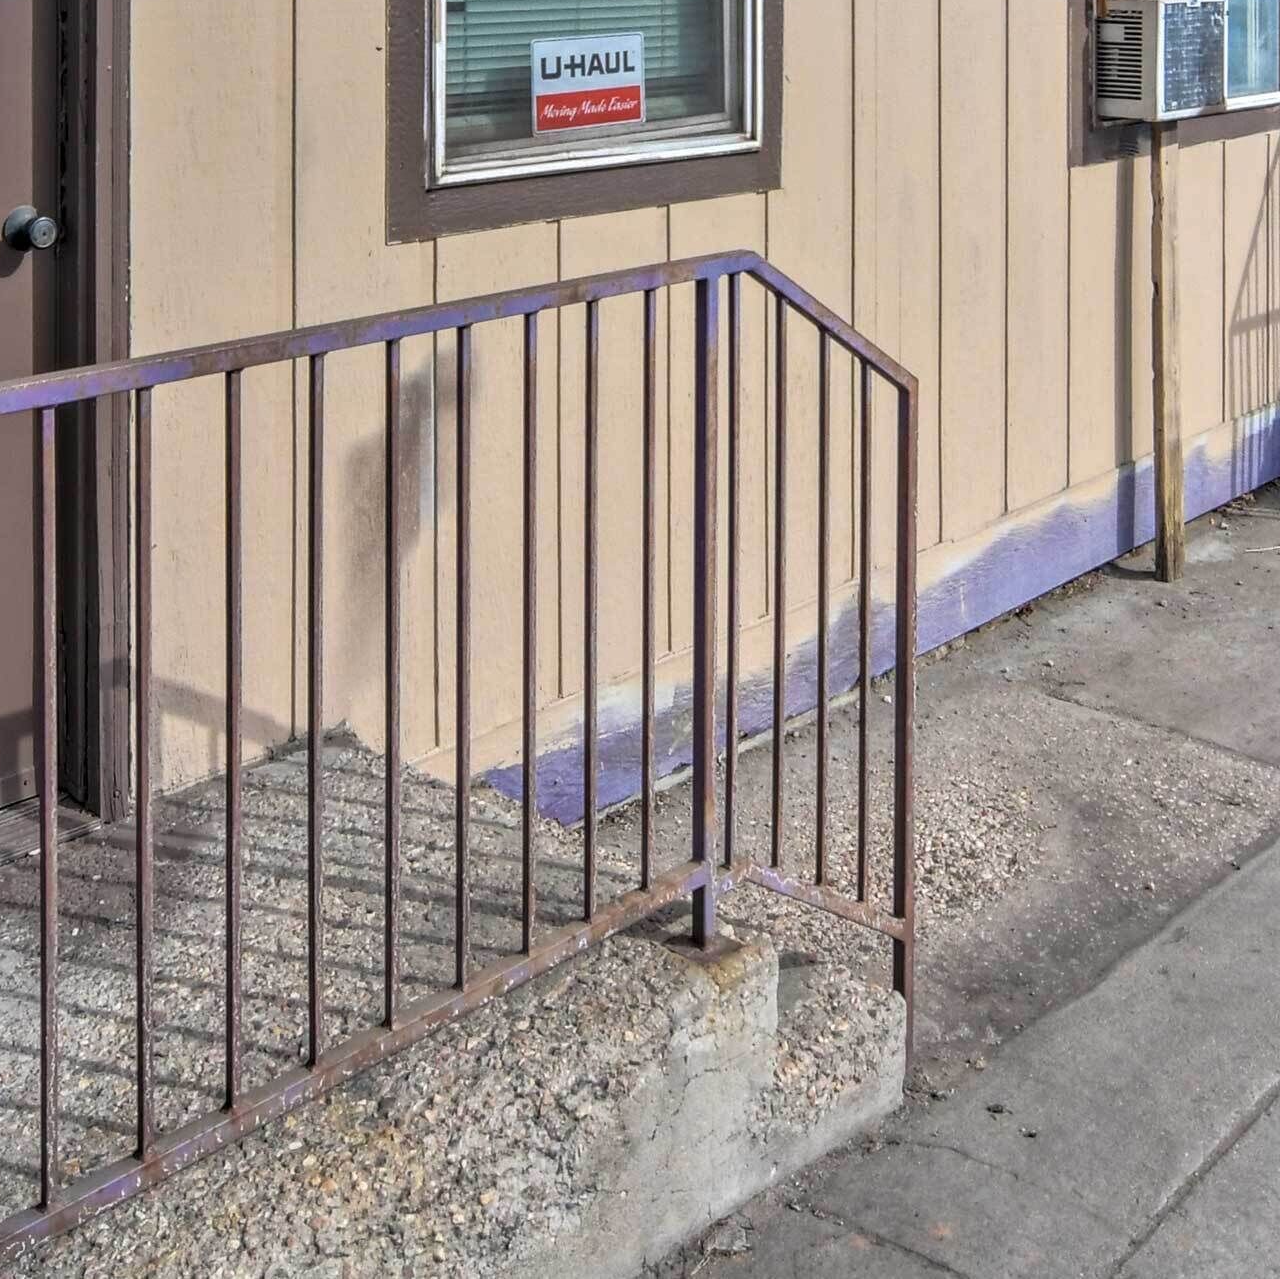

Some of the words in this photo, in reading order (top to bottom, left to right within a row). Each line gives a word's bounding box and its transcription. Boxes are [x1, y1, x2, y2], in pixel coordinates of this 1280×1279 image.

[540, 50, 635, 80] U-HAUL
[540, 103, 578, 122] Moving
[579, 99, 607, 115] Made
[607, 95, 638, 112] Easier
